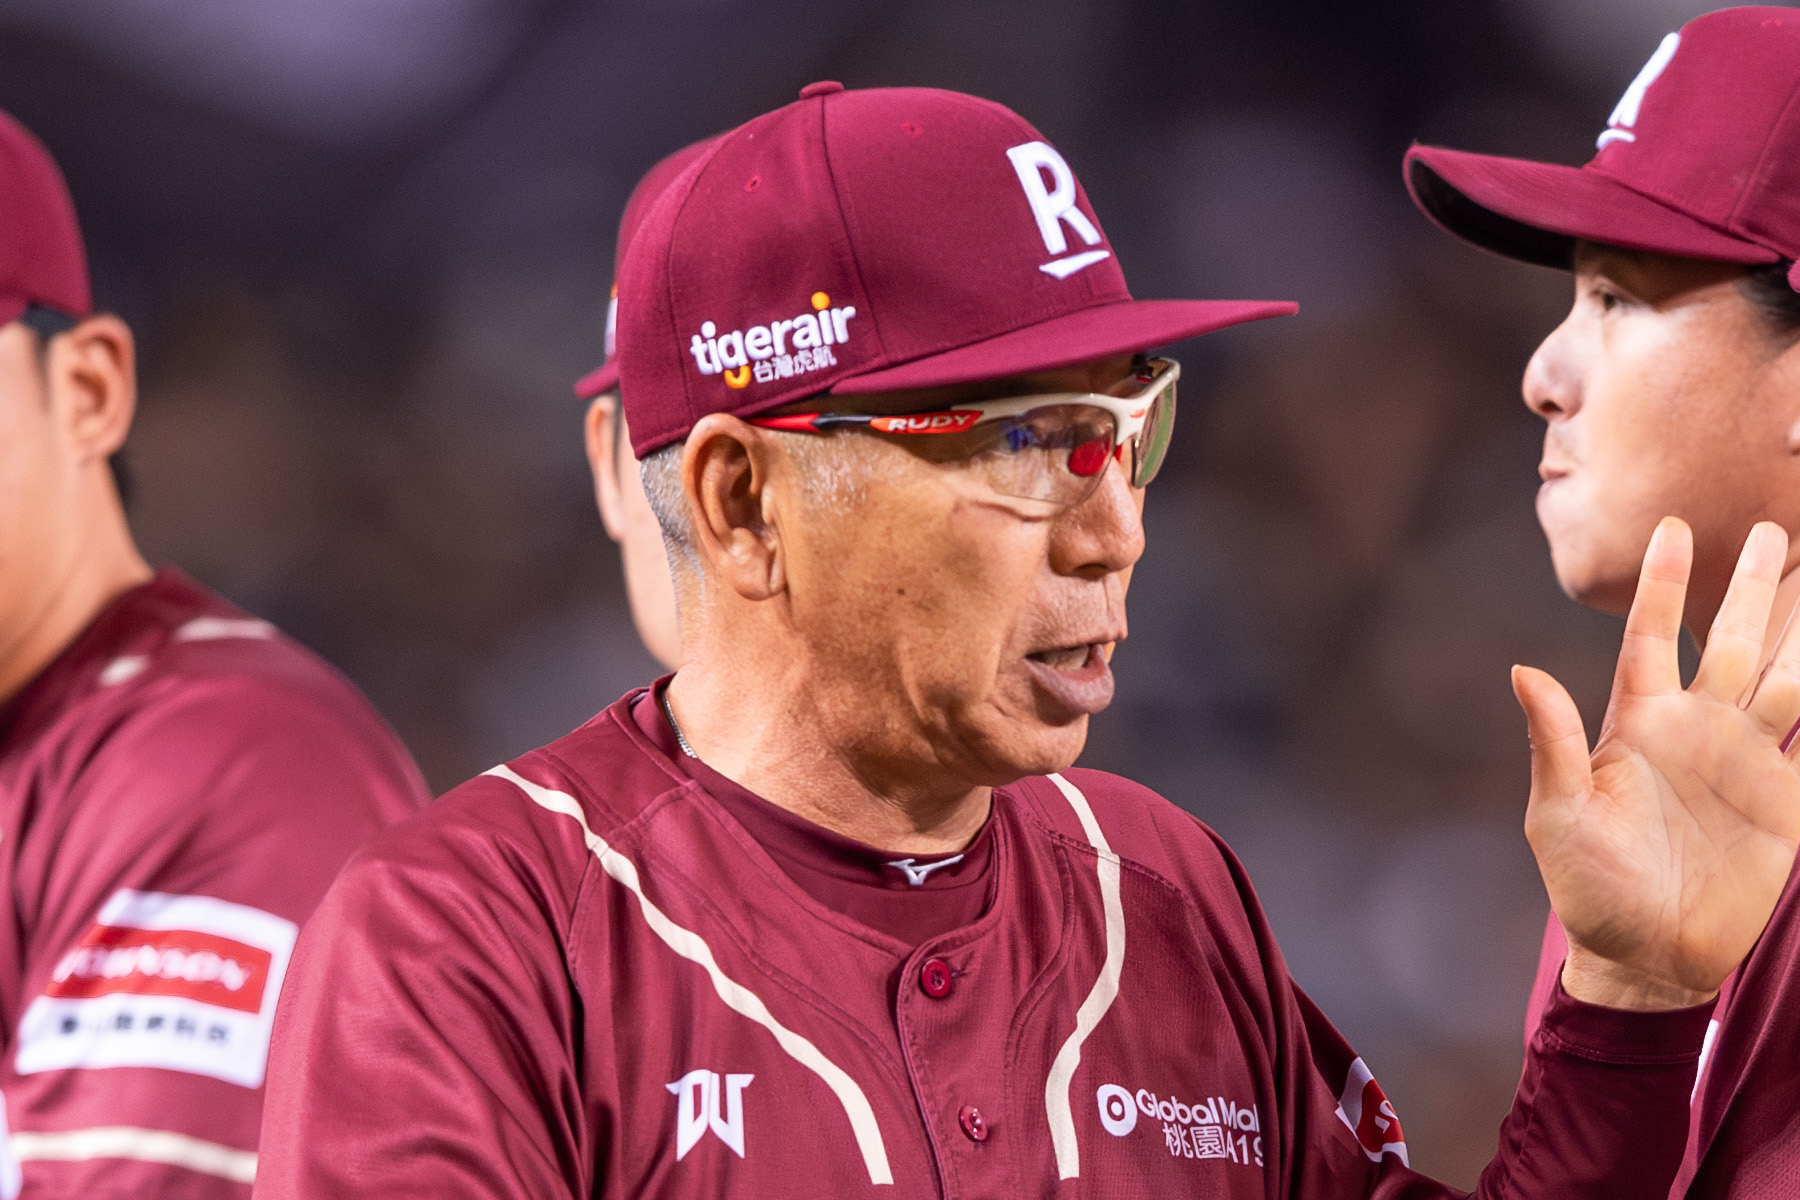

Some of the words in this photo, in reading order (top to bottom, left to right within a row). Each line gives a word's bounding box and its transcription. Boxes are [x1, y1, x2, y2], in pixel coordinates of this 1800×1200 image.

[1006, 140, 1102, 256] R
[689, 291, 857, 389] tigerair
[888, 414, 970, 432] RUDY
[1136, 1088, 1221, 1125] Global
